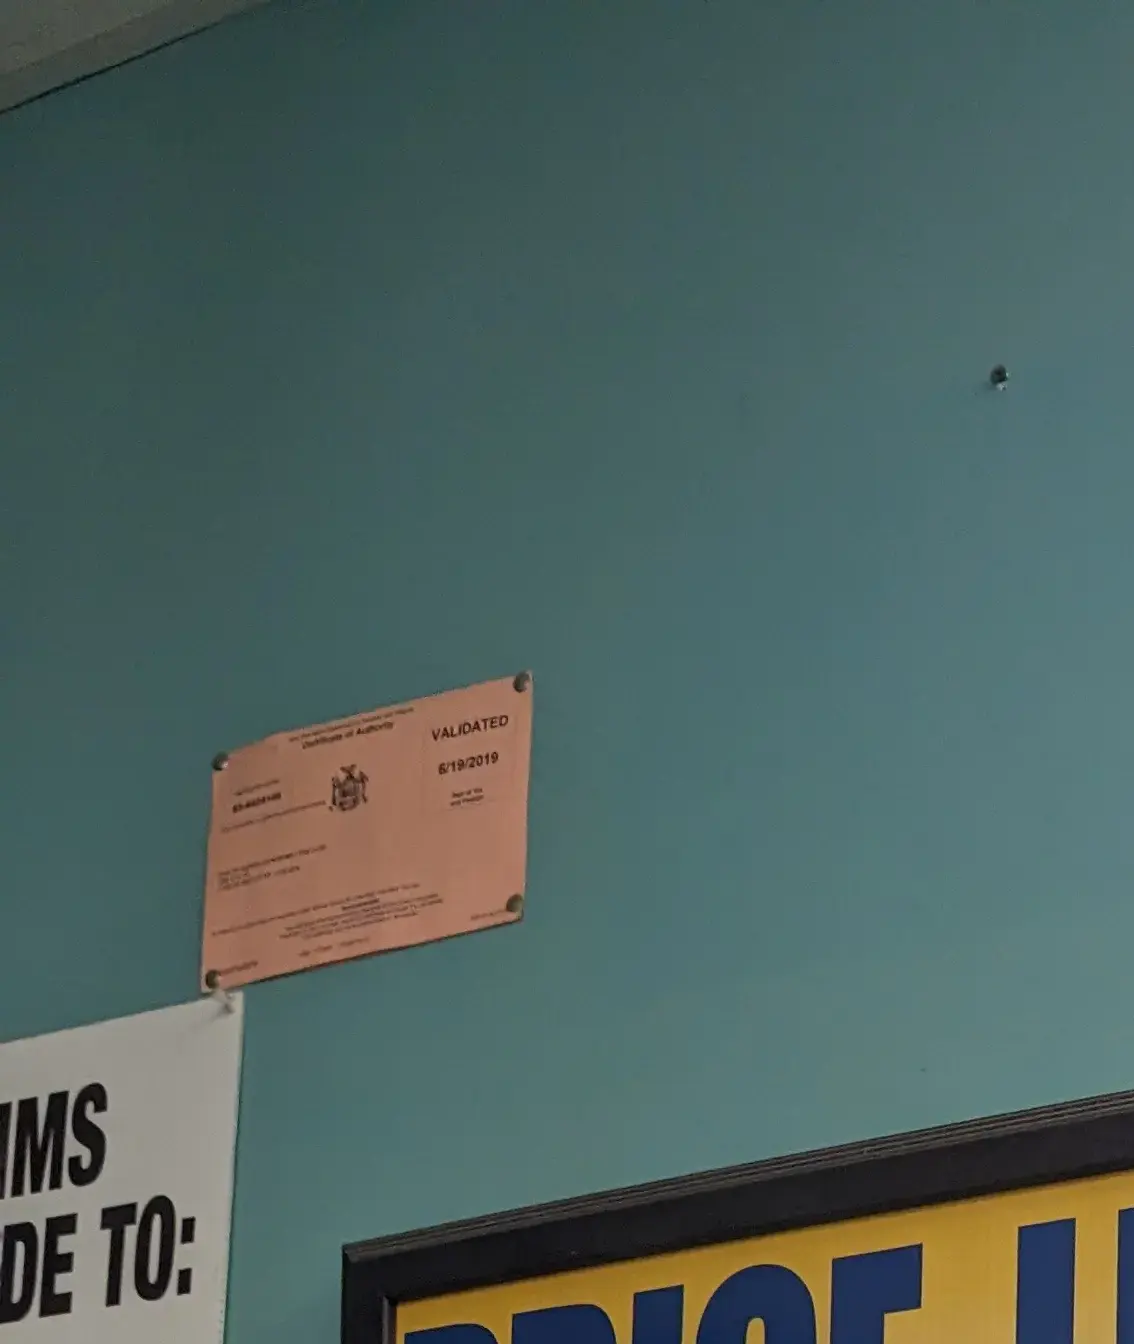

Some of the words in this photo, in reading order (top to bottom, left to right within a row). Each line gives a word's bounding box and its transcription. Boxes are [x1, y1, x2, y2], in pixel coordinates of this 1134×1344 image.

[431, 714, 509, 742] VALIDATED
[438, 751, 499, 776] 6/19/2019
[101, 1195, 196, 1308] TO:
